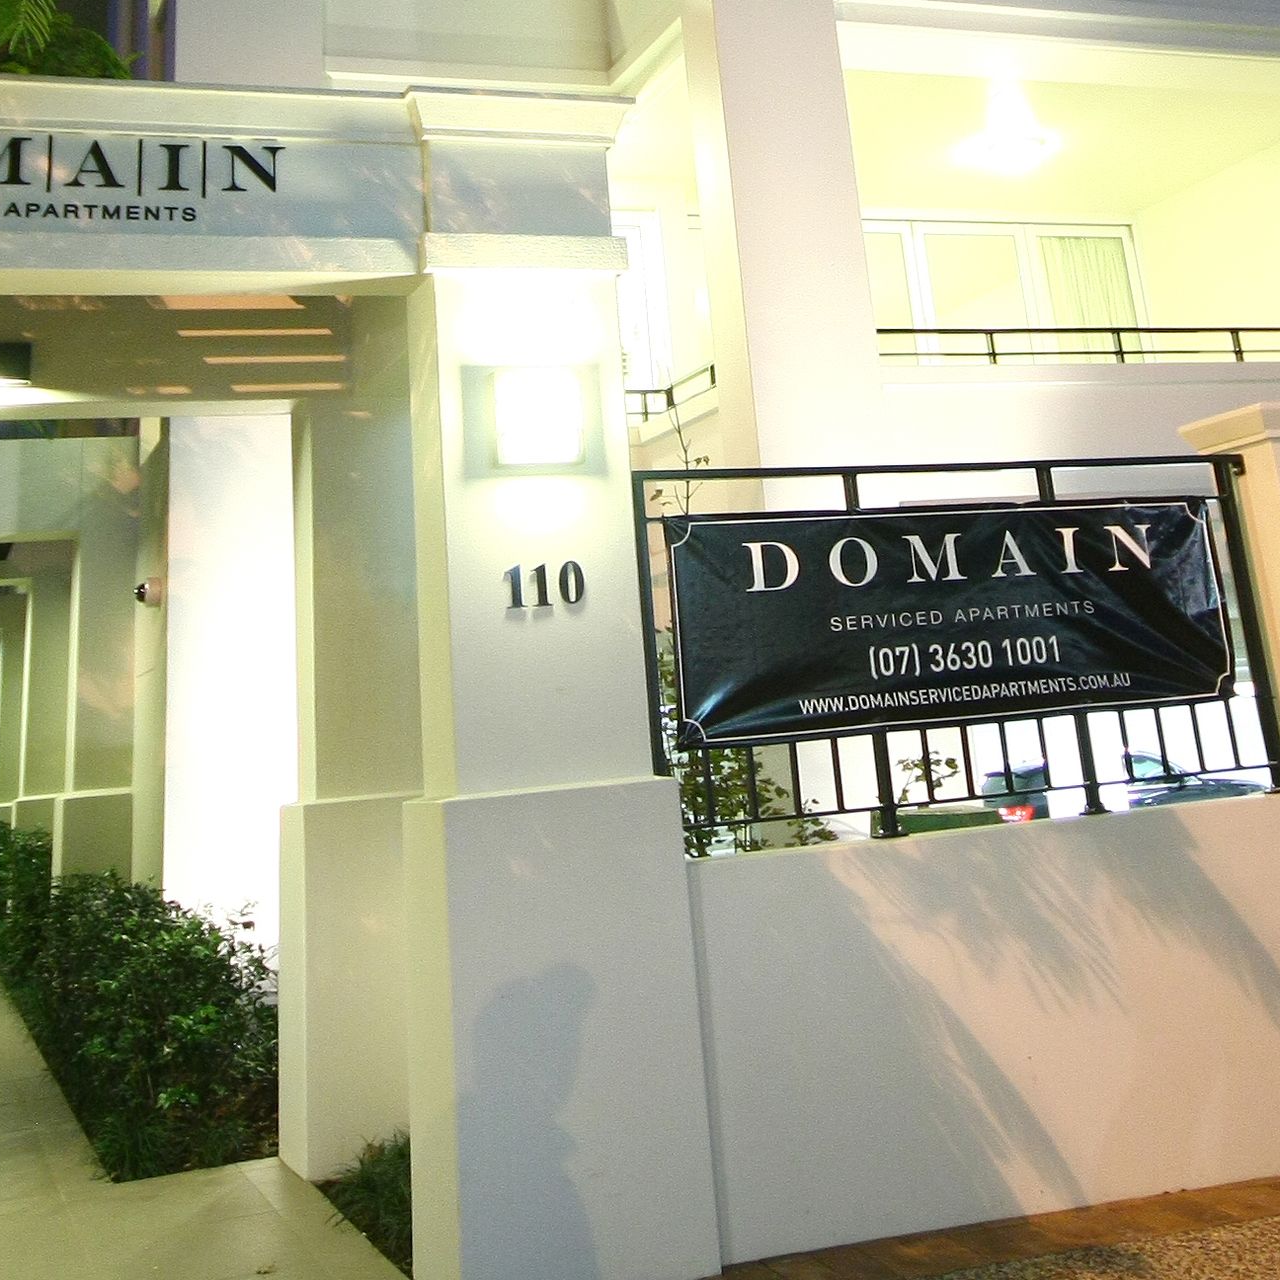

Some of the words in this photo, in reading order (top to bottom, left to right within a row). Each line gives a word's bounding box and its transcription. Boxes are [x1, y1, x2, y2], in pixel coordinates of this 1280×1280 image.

[3, 202, 198, 223] APARTMENTS
[741, 523, 1154, 593] DOMAIN
[503, 560, 585, 610] 110
[829, 609, 944, 632] SERVICED
[953, 599, 1096, 624] APARTMENTS
[868, 642, 922, 681] (07)
[928, 639, 994, 673] 3630
[1000, 634, 1062, 667] 1001
[798, 671, 1132, 716] WWW.DOMAINSERVICEDAPARTMENTS.COM.AU
